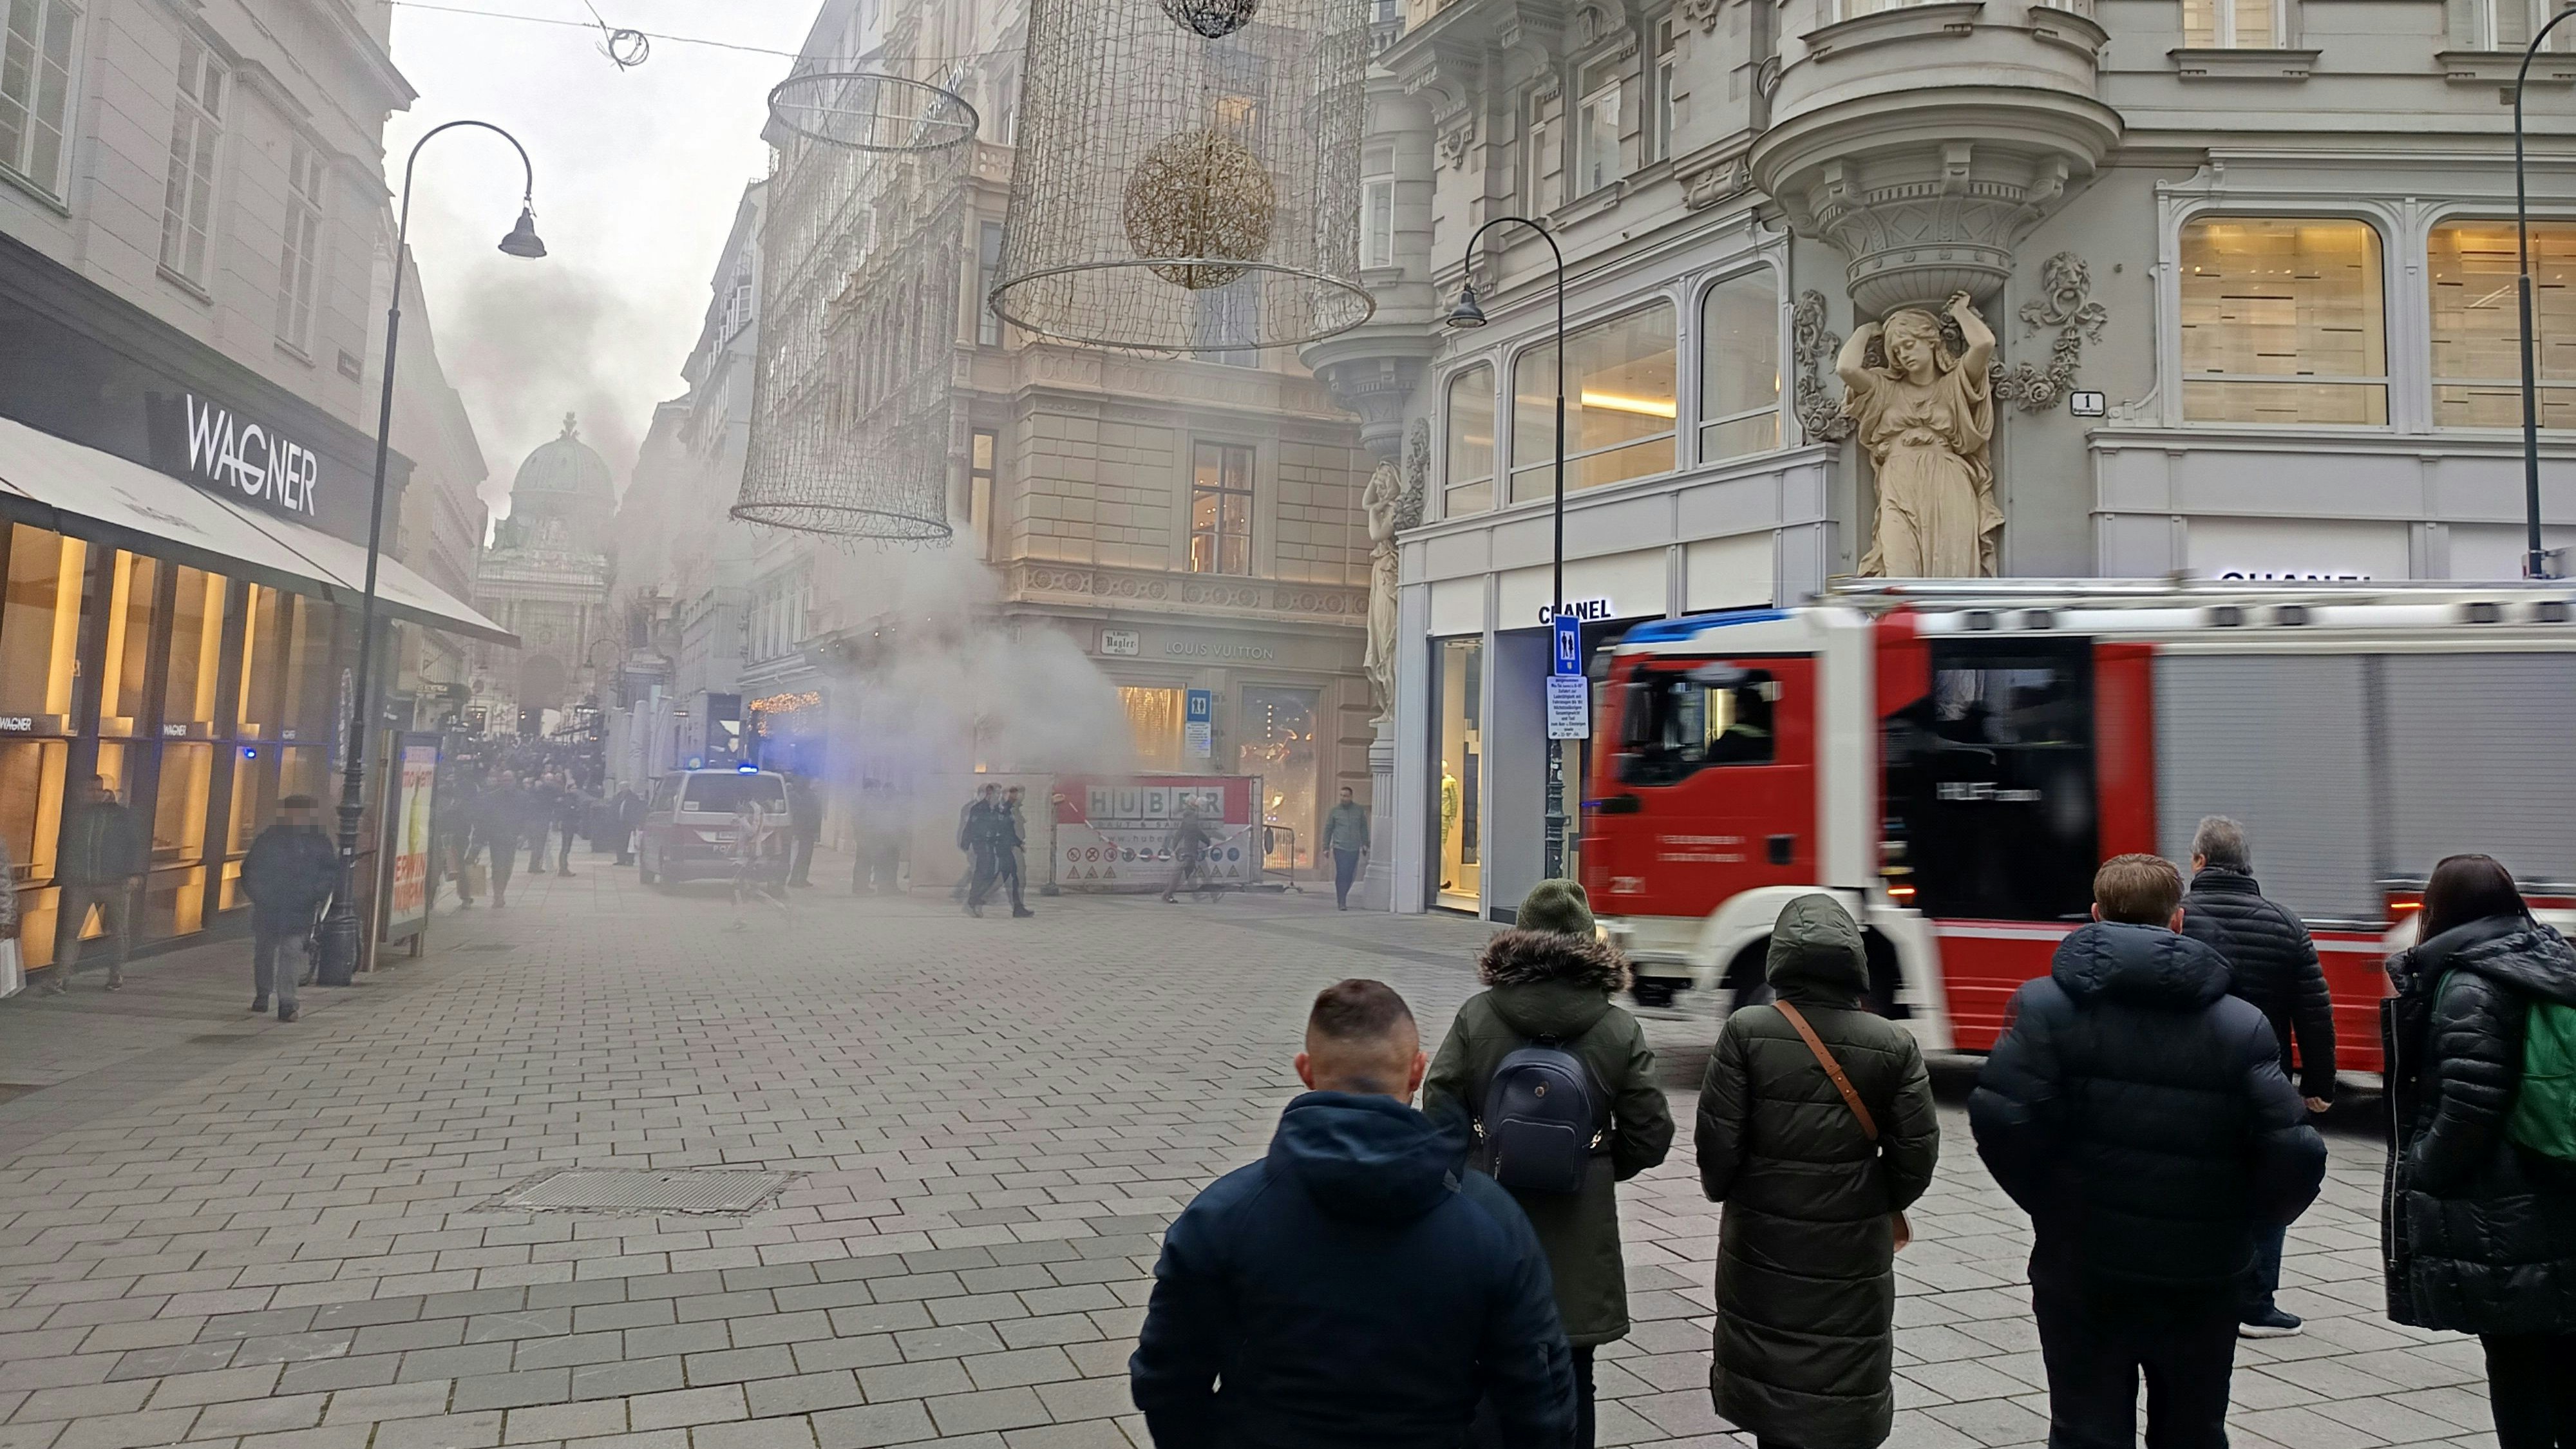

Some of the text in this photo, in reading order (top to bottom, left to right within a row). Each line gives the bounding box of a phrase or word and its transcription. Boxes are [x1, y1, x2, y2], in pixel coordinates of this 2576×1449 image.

[2085, 394, 2090, 408] 1
[186, 393, 317, 516] WAGNER
[1166, 642, 1273, 659] LOUIS VUITTON
[0, 717, 32, 731] WAGNER
